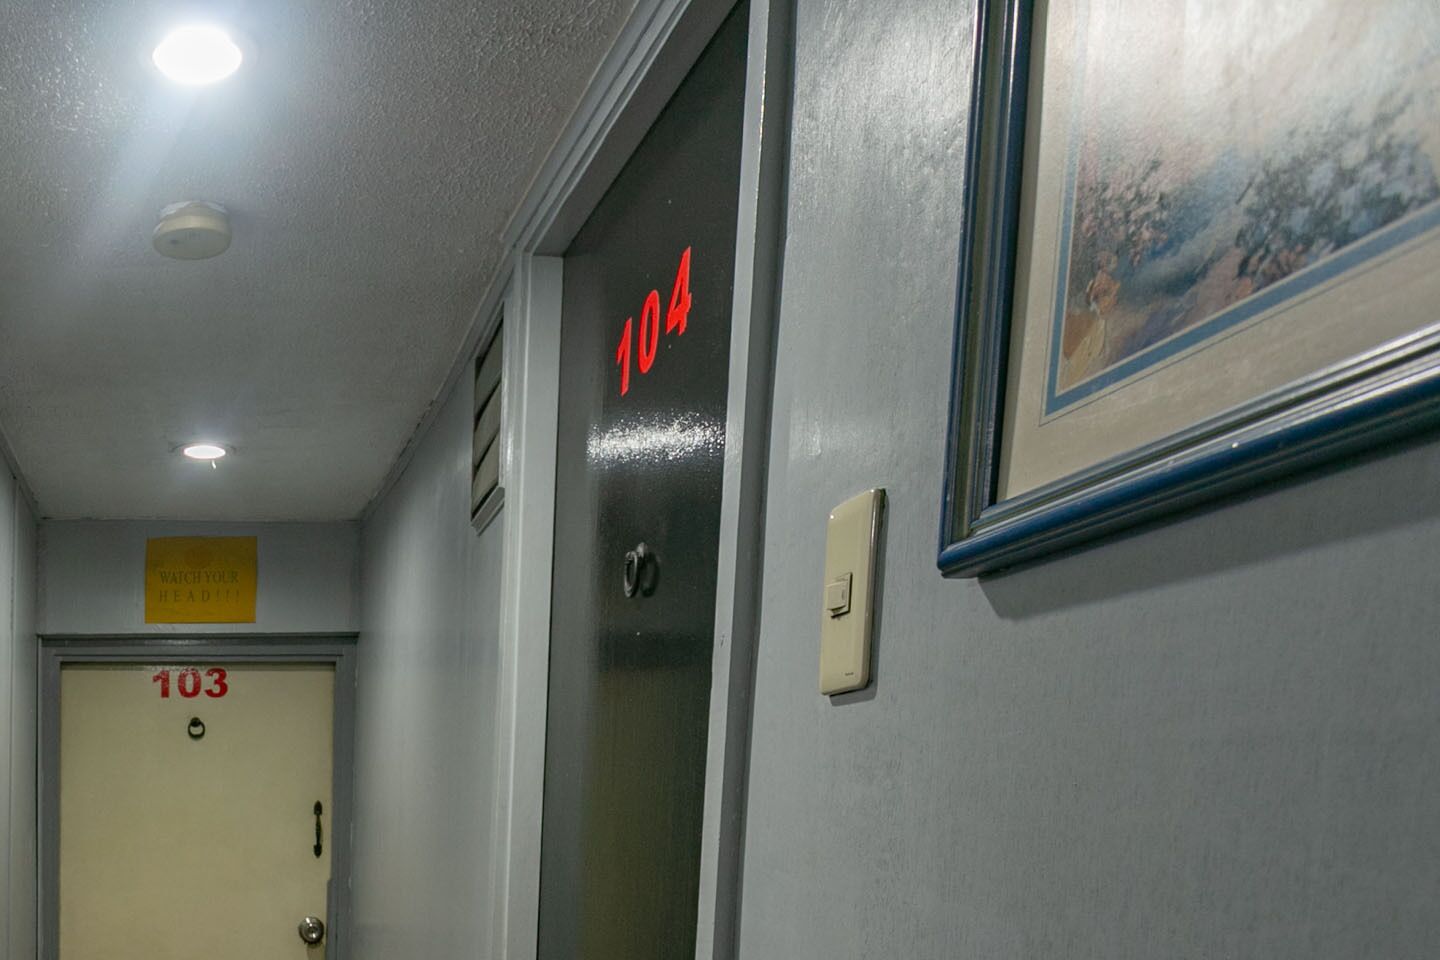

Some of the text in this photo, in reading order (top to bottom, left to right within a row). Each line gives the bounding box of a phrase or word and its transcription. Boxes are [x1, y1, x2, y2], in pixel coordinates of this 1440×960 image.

[616, 246, 692, 397] 104
[160, 570, 239, 584] WATCH YOUR
[152, 668, 228, 698] 103
